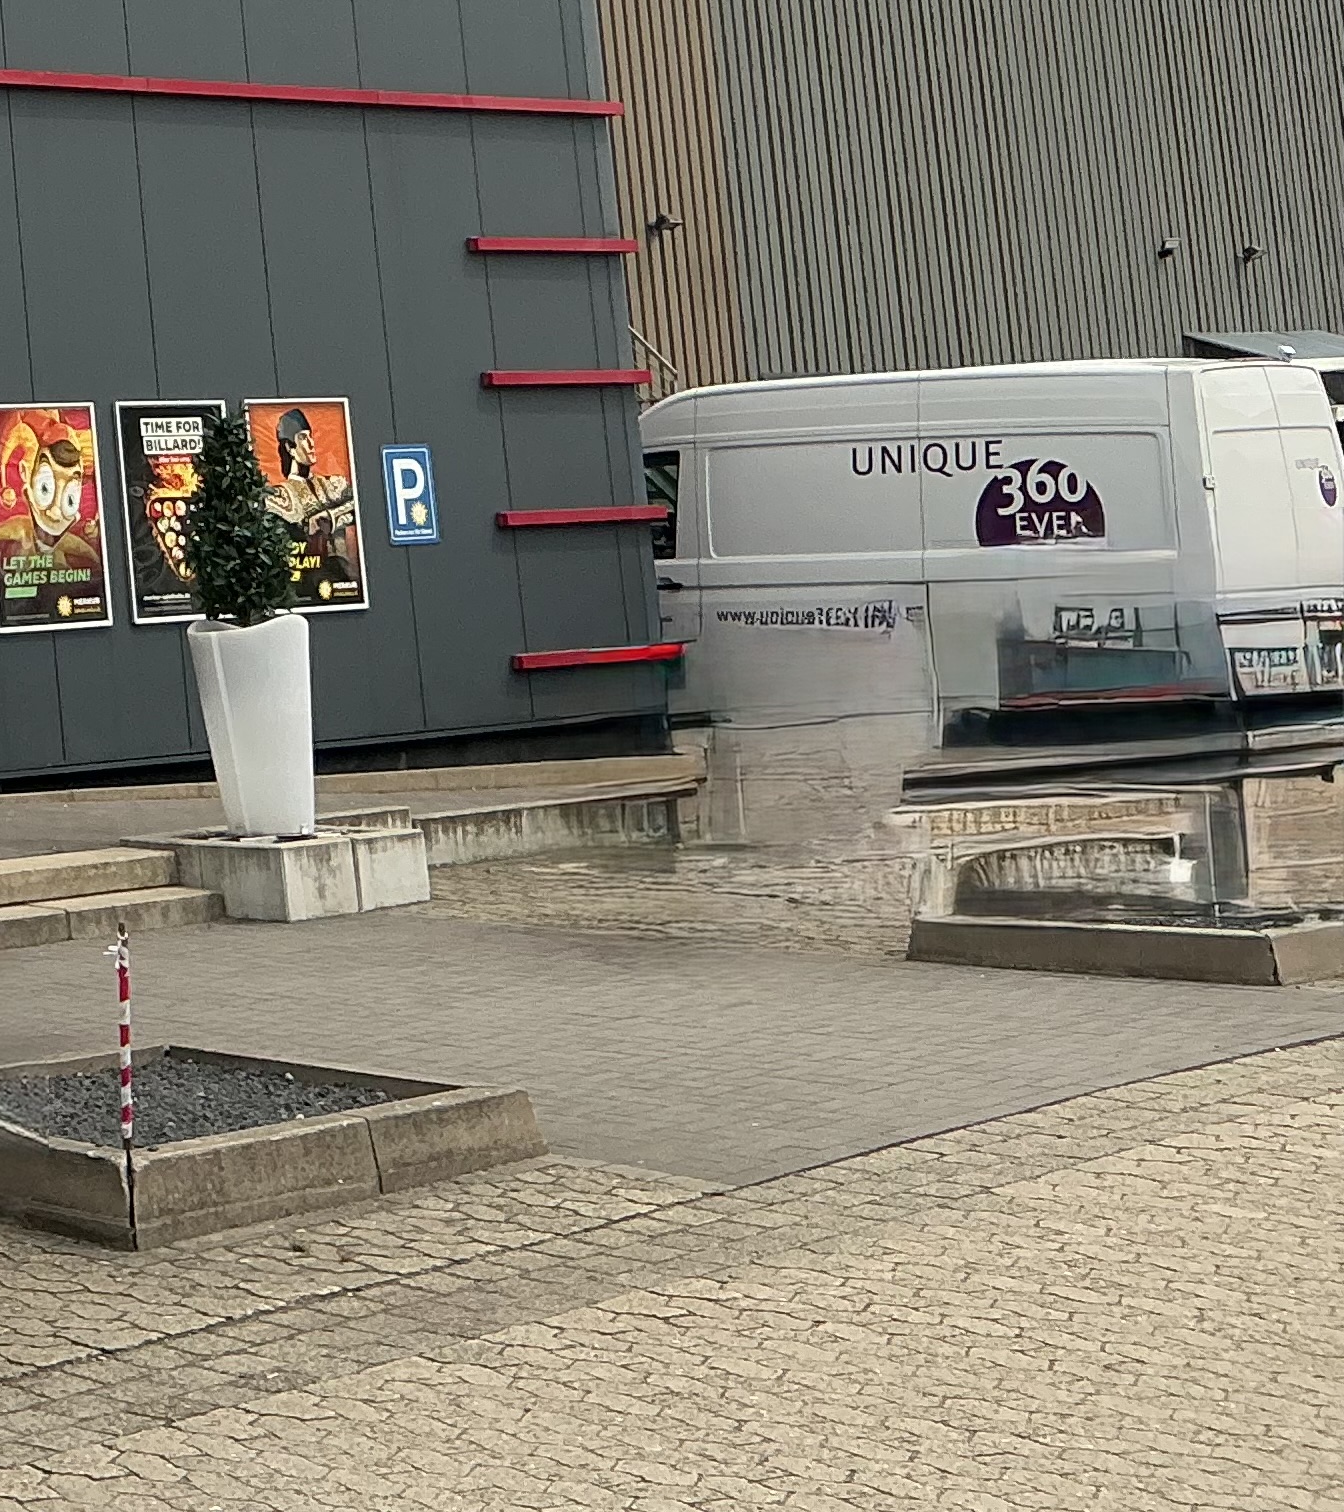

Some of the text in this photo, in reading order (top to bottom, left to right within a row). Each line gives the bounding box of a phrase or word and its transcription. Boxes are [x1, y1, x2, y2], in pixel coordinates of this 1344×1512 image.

[142, 421, 200, 434] TIME FOR
[145, 439, 202, 451] BILLARD!
[852, 440, 1005, 477] UNIQUE
[393, 458, 424, 525] P
[996, 459, 1088, 517] 360
[3, 555, 53, 570] LET THE
[4, 568, 91, 586] GAMES BEGIN!
